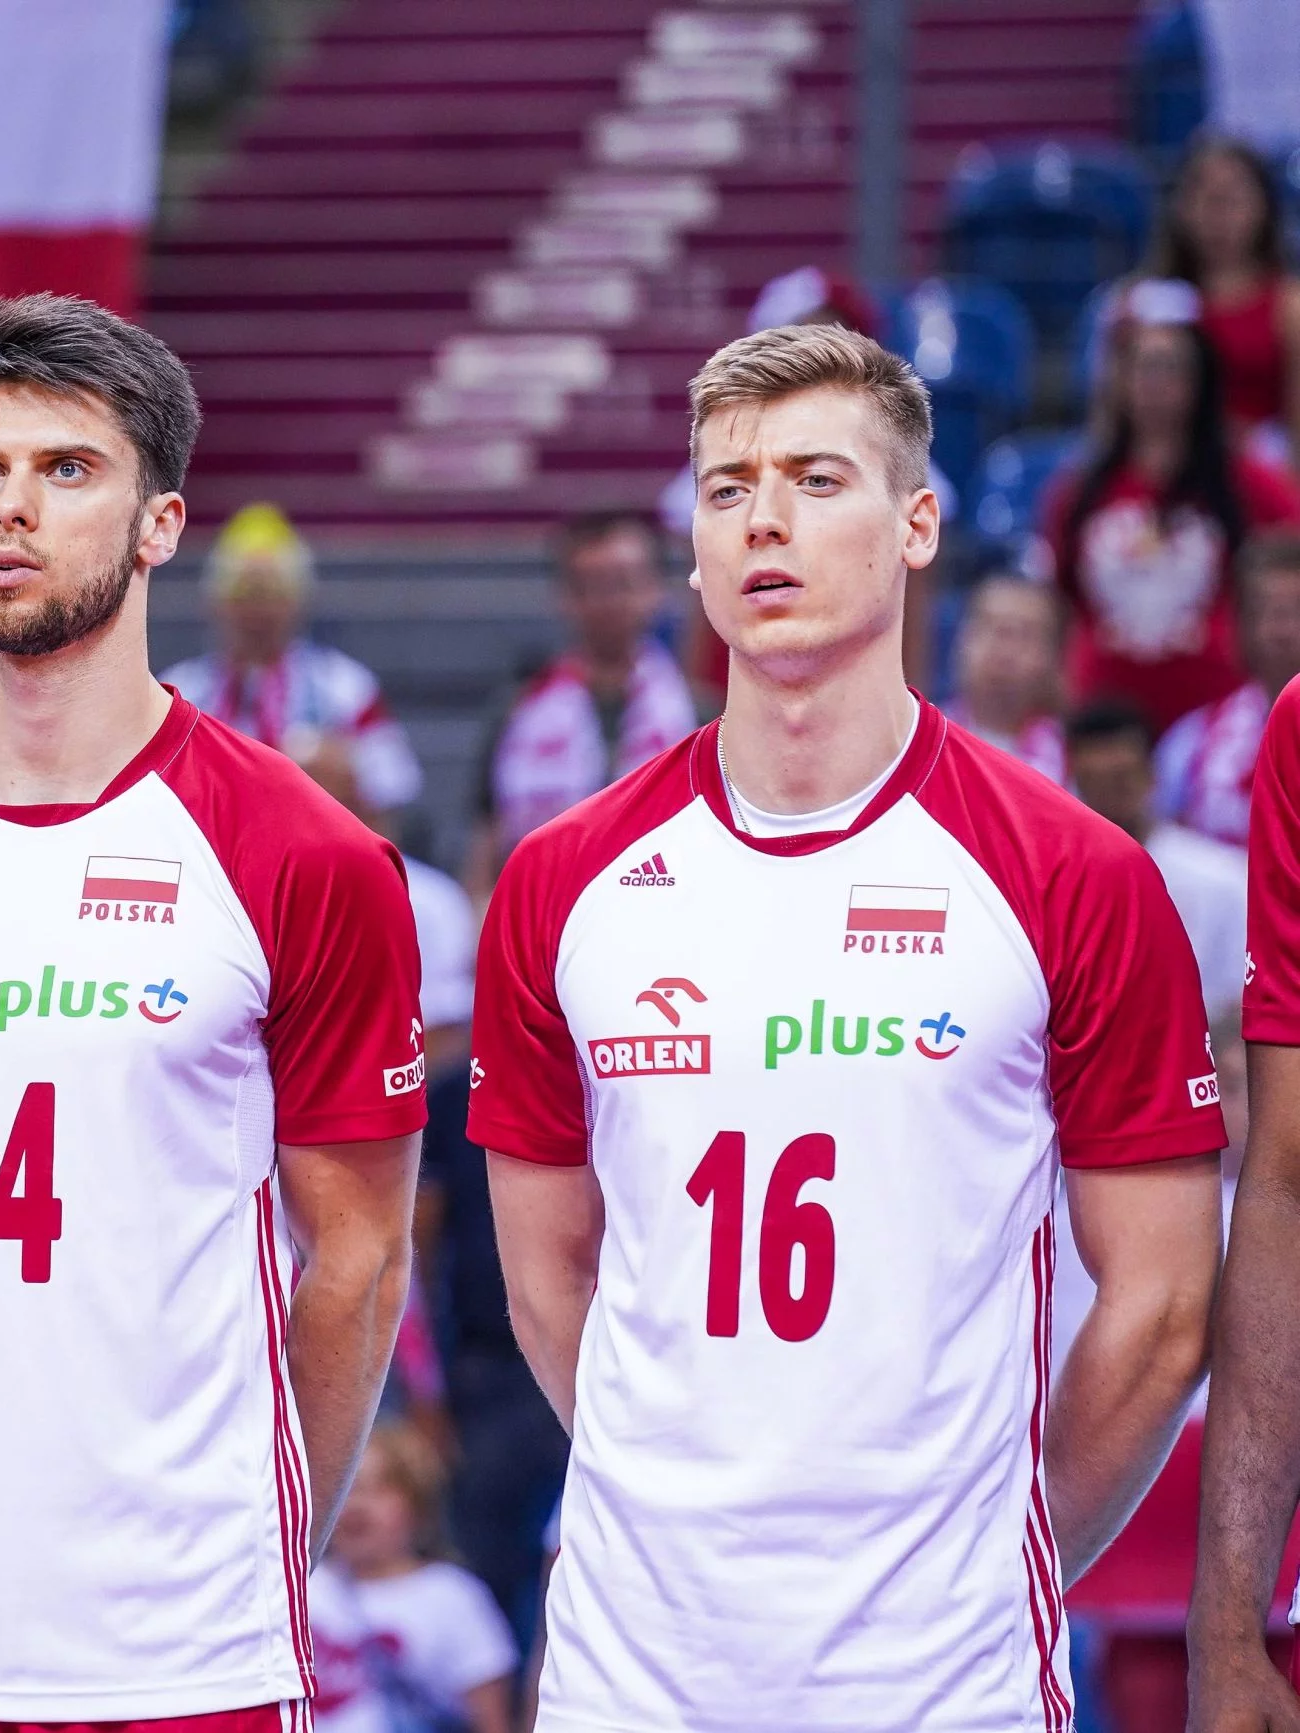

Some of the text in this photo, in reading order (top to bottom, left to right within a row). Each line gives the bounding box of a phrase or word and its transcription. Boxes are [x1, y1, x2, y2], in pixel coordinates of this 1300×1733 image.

[619, 873, 675, 887] adidas
[78, 902, 175, 924] POLSKA
[843, 934, 945, 955] POLSKA
[765, 999, 905, 1070] plus
[594, 1040, 702, 1074] ORLEN
[685, 1129, 837, 1343] 16
